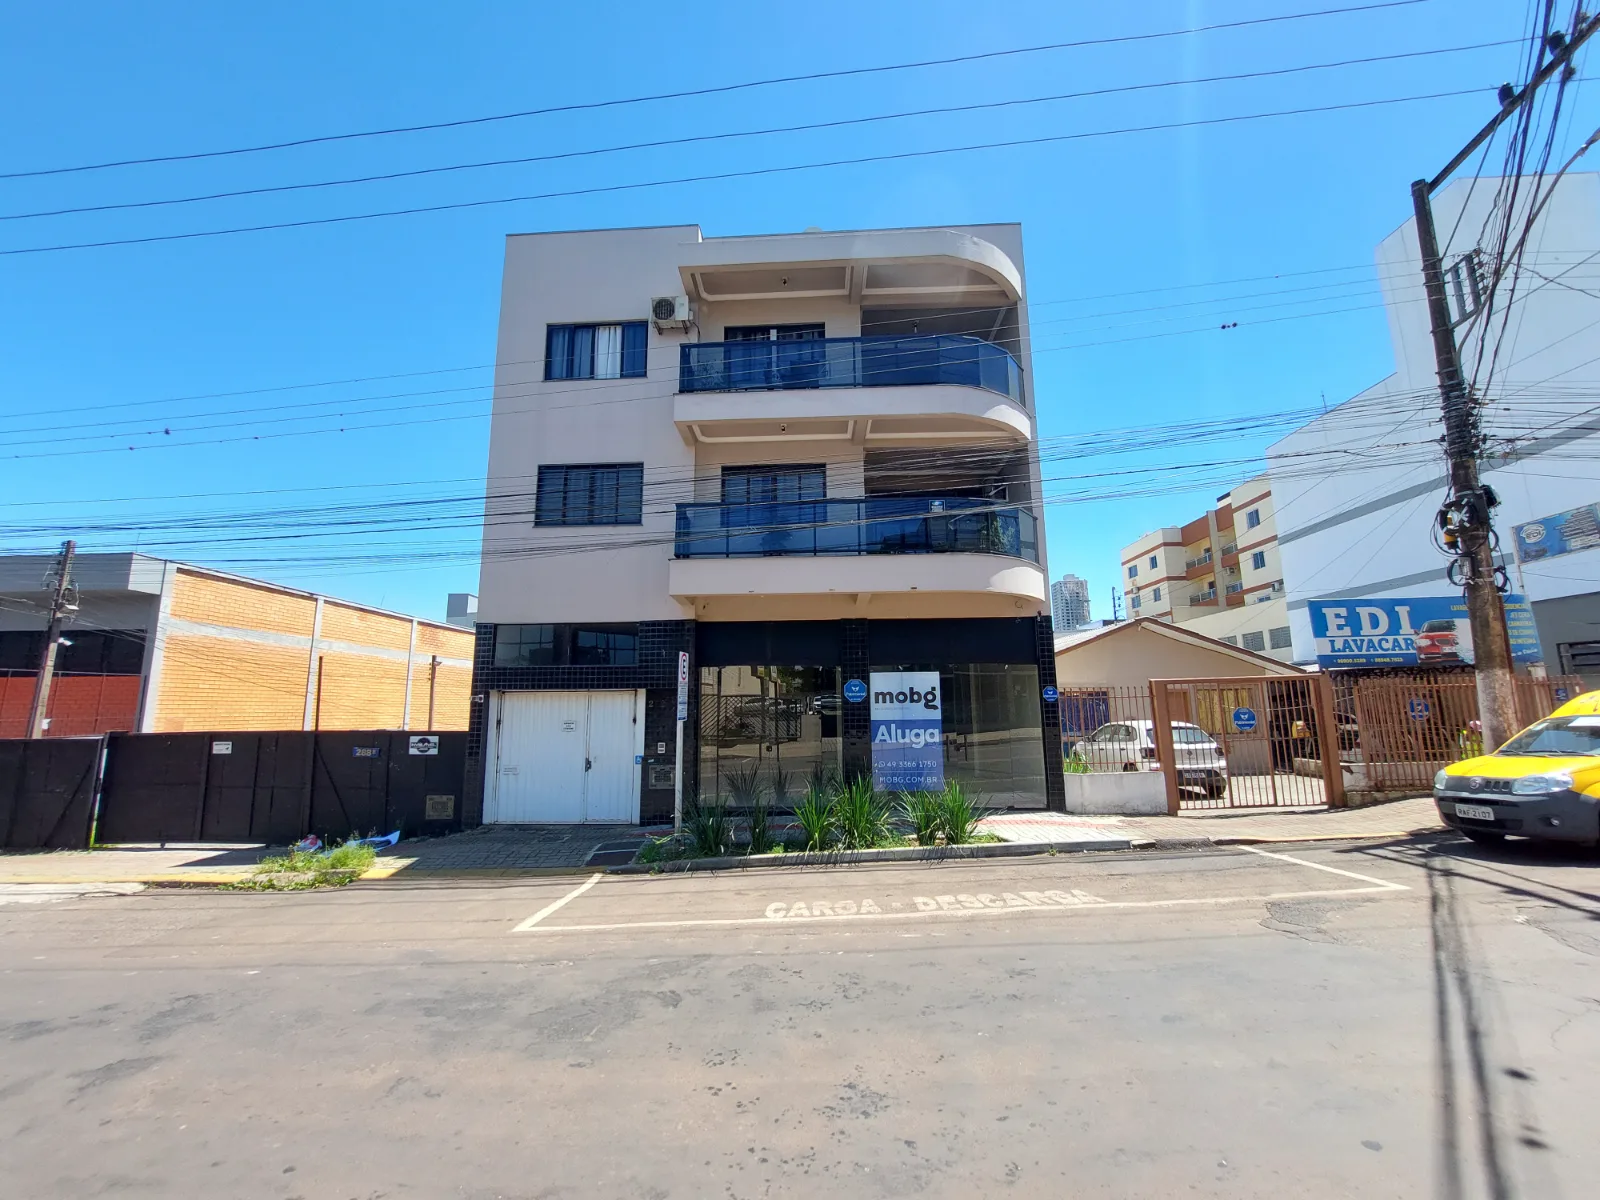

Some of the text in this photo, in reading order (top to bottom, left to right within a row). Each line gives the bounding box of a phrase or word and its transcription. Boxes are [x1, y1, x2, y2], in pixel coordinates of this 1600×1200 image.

[1321, 605, 1415, 637] EDI
[1328, 638, 1417, 653] LAVACAR
[874, 686, 939, 710] mobg
[874, 723, 940, 749] Aluga
[886, 760, 937, 768] 49 3366 1750
[879, 776, 938, 784] MOBG.COM.BR
[764, 898, 882, 918] CARGA
[912, 889, 1108, 912] DESCARGA
